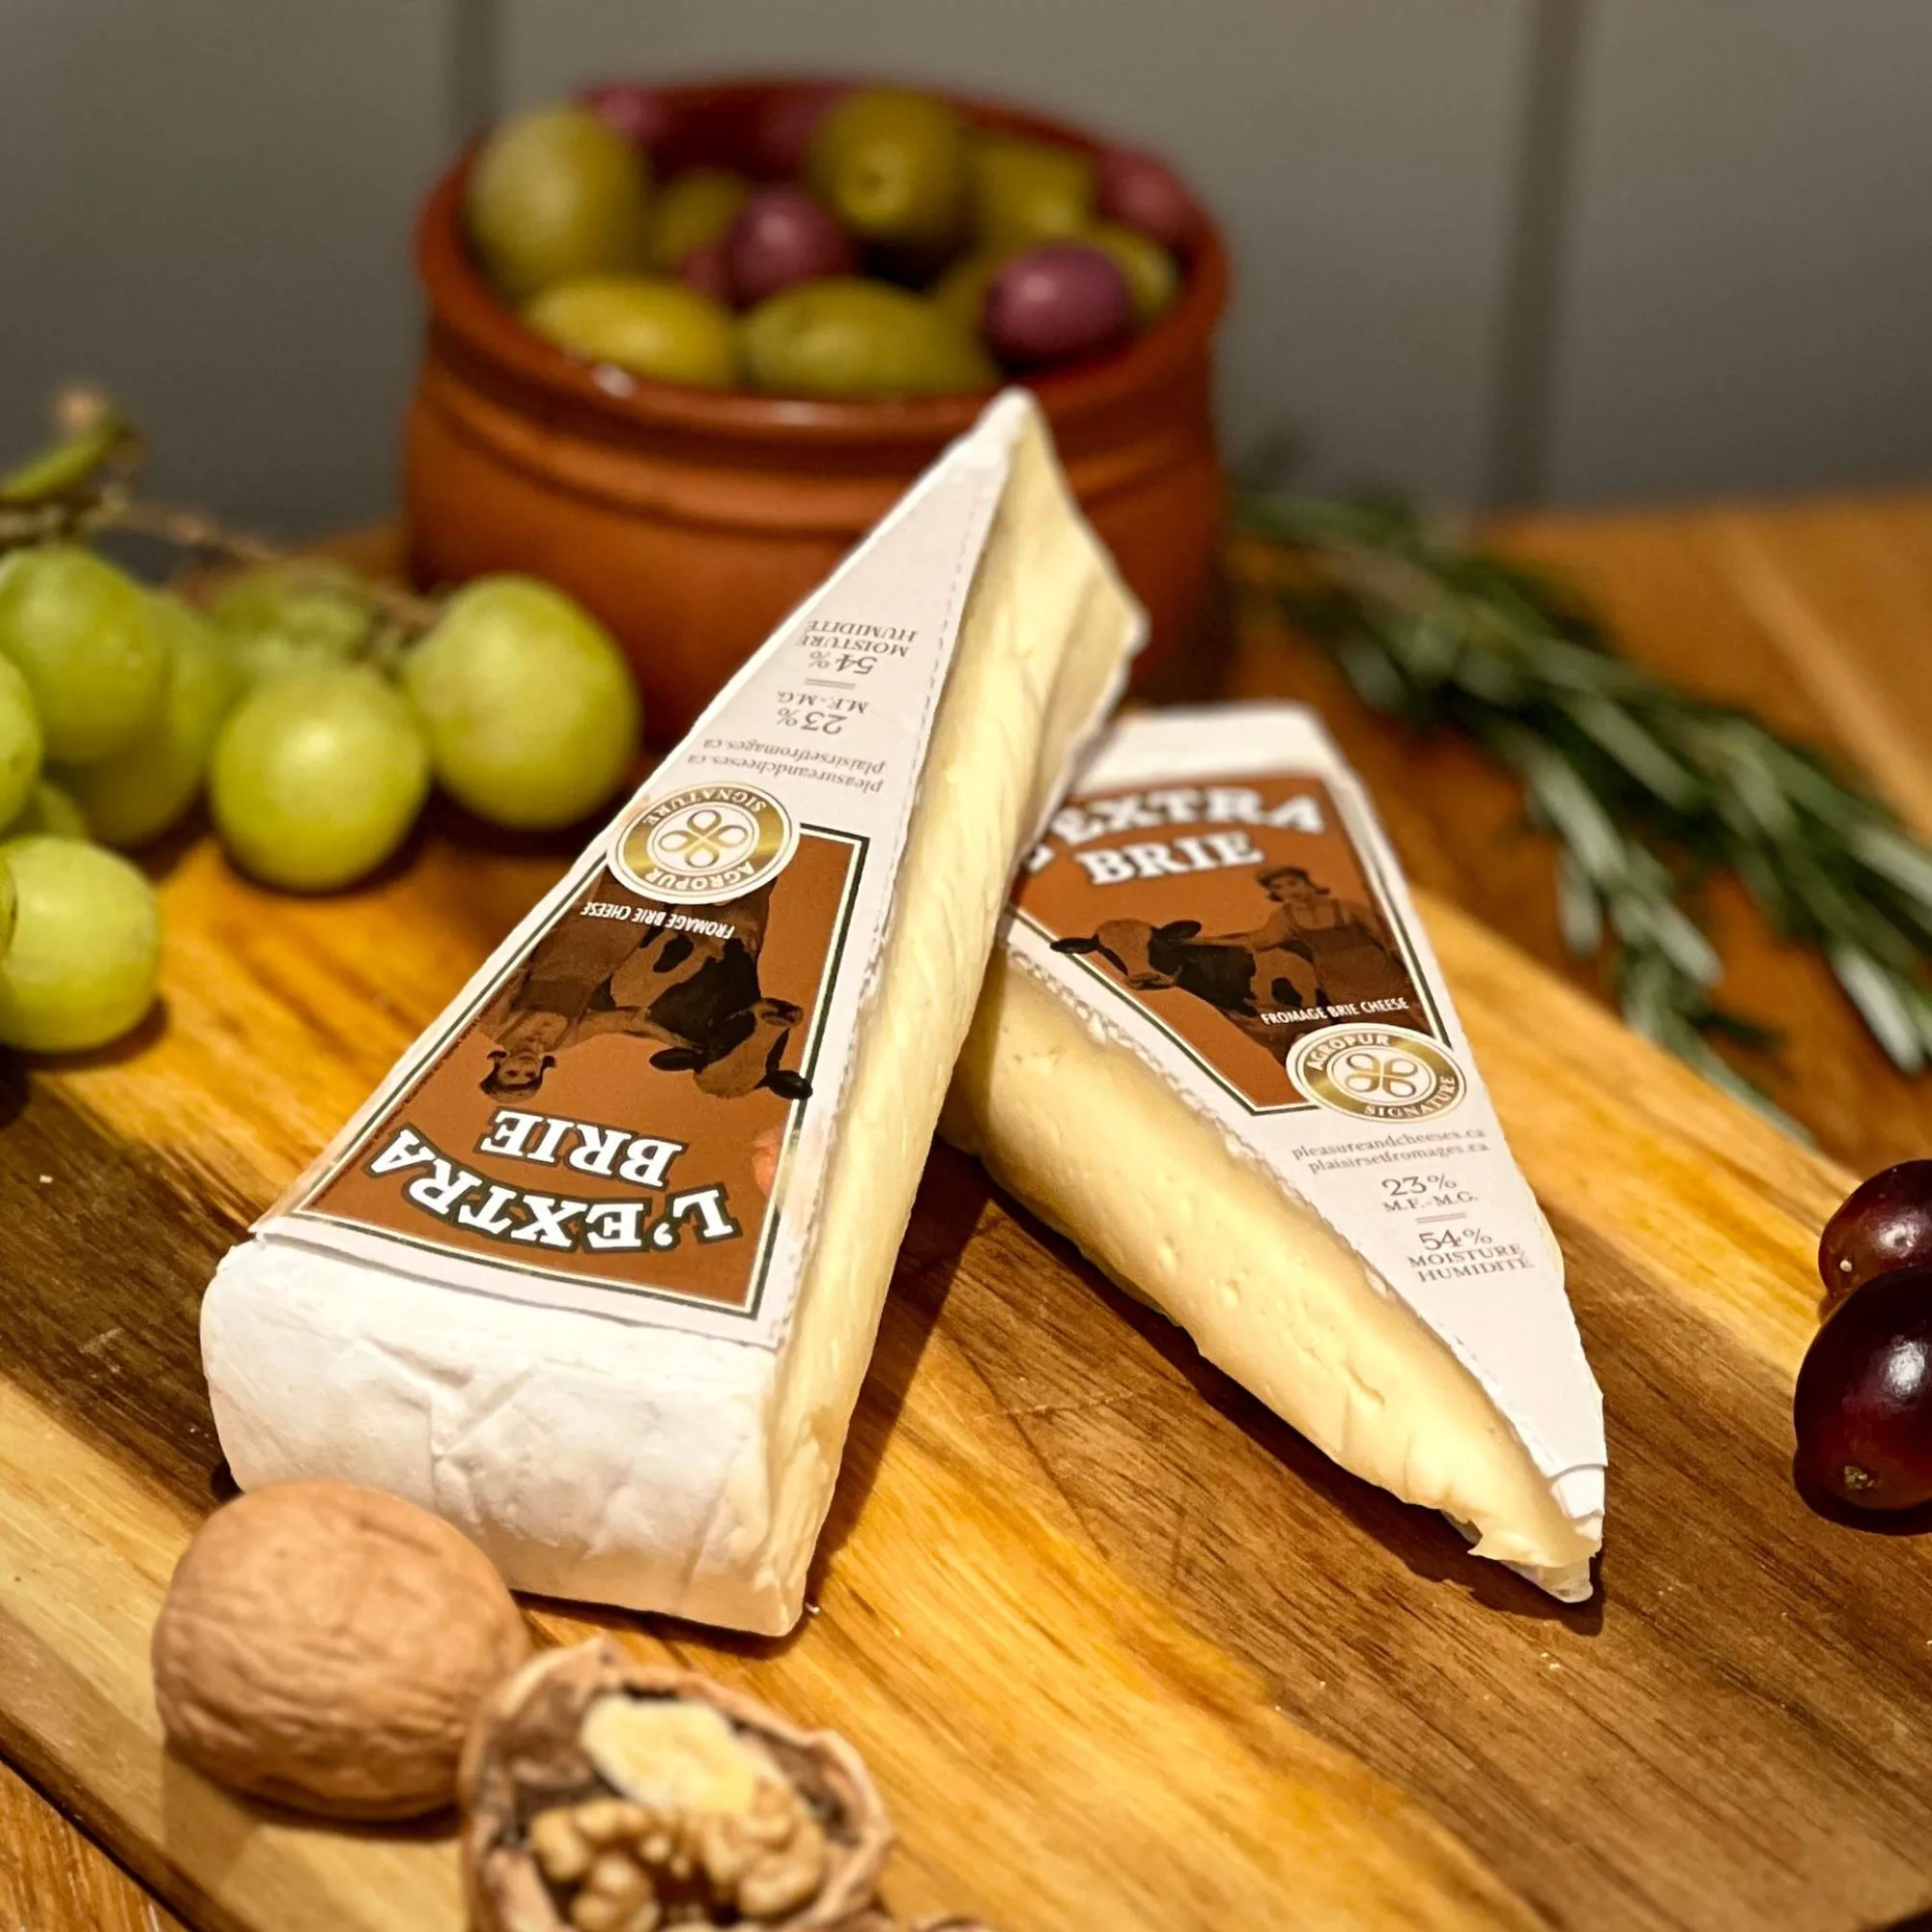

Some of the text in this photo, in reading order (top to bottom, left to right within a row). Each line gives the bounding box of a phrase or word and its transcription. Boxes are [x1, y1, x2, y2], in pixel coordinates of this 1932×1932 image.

[809, 650, 878, 675] 54%
[776, 706, 847, 735] 23%
[687, 753, 885, 794] pleasureandcheeses.ca
[703, 738, 887, 775] plaisirsetfromages.ca
[641, 787, 768, 826] SIGNATURE
[1074, 830, 1265, 885] BRIE
[644, 861, 756, 892] AGROPUR
[581, 900, 736, 940] FROMAGE BRIE CHEESE
[1260, 996, 1410, 1026] FROMAGE BRIE CHEESE
[1306, 1032, 1391, 1071] AGROPUR
[1364, 1075, 1456, 1118] SIGNATURE
[479, 1109, 684, 1188] BRIE
[1291, 1126, 1488, 1161] pleasureandcheeses.ca
[1308, 1141, 1490, 1175] plaisirsetfromages.ca
[369, 1128, 735, 1249] L'EXTRA
[1380, 1173, 1458, 1197] 23%
[1406, 1243, 1524, 1268] MOISTURE
[1418, 1227, 1493, 1251] 54%
